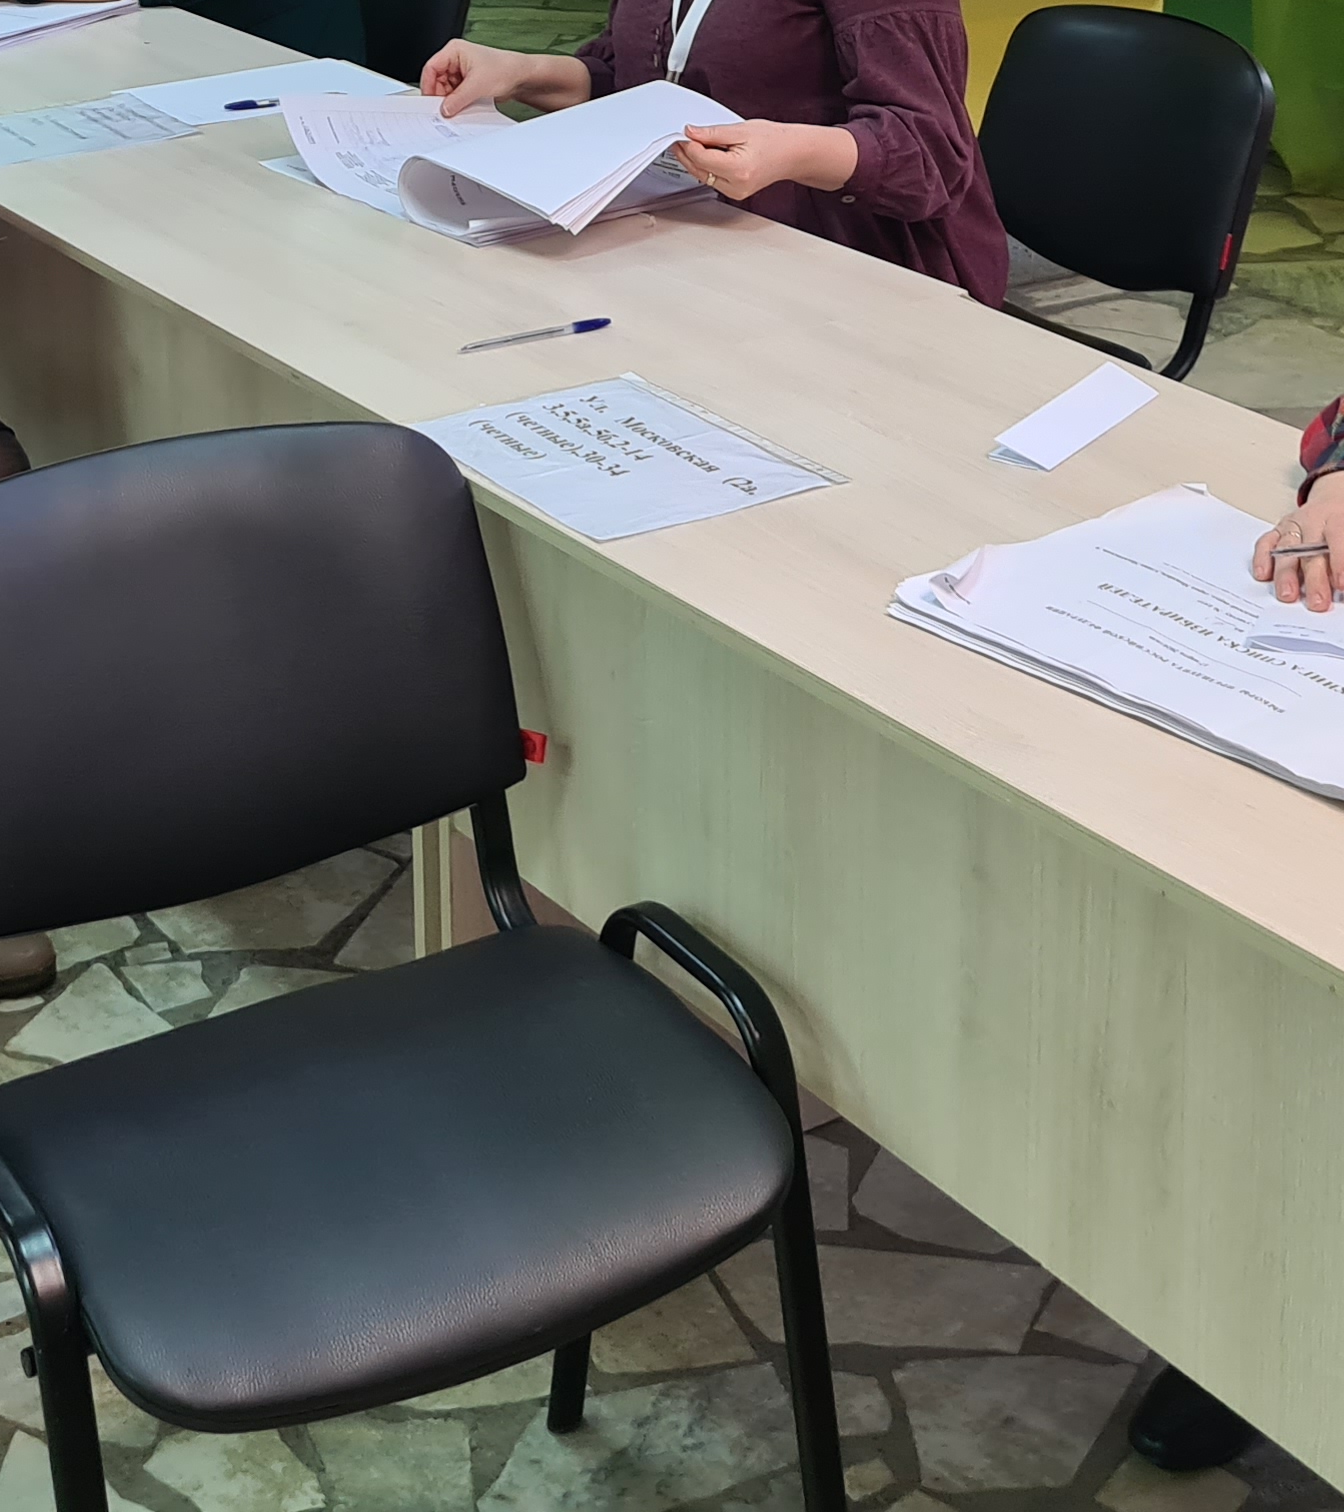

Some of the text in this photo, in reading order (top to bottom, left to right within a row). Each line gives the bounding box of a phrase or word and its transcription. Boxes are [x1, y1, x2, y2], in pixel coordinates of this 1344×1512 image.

[468, 419, 548, 461] (четные)
[579, 395, 608, 414] Ул.
[614, 416, 720, 473] Московская
[1097, 582, 1213, 637] ИЗБИРАТЕЛЕЙ
[1216, 635, 1287, 667] СПИСКА
